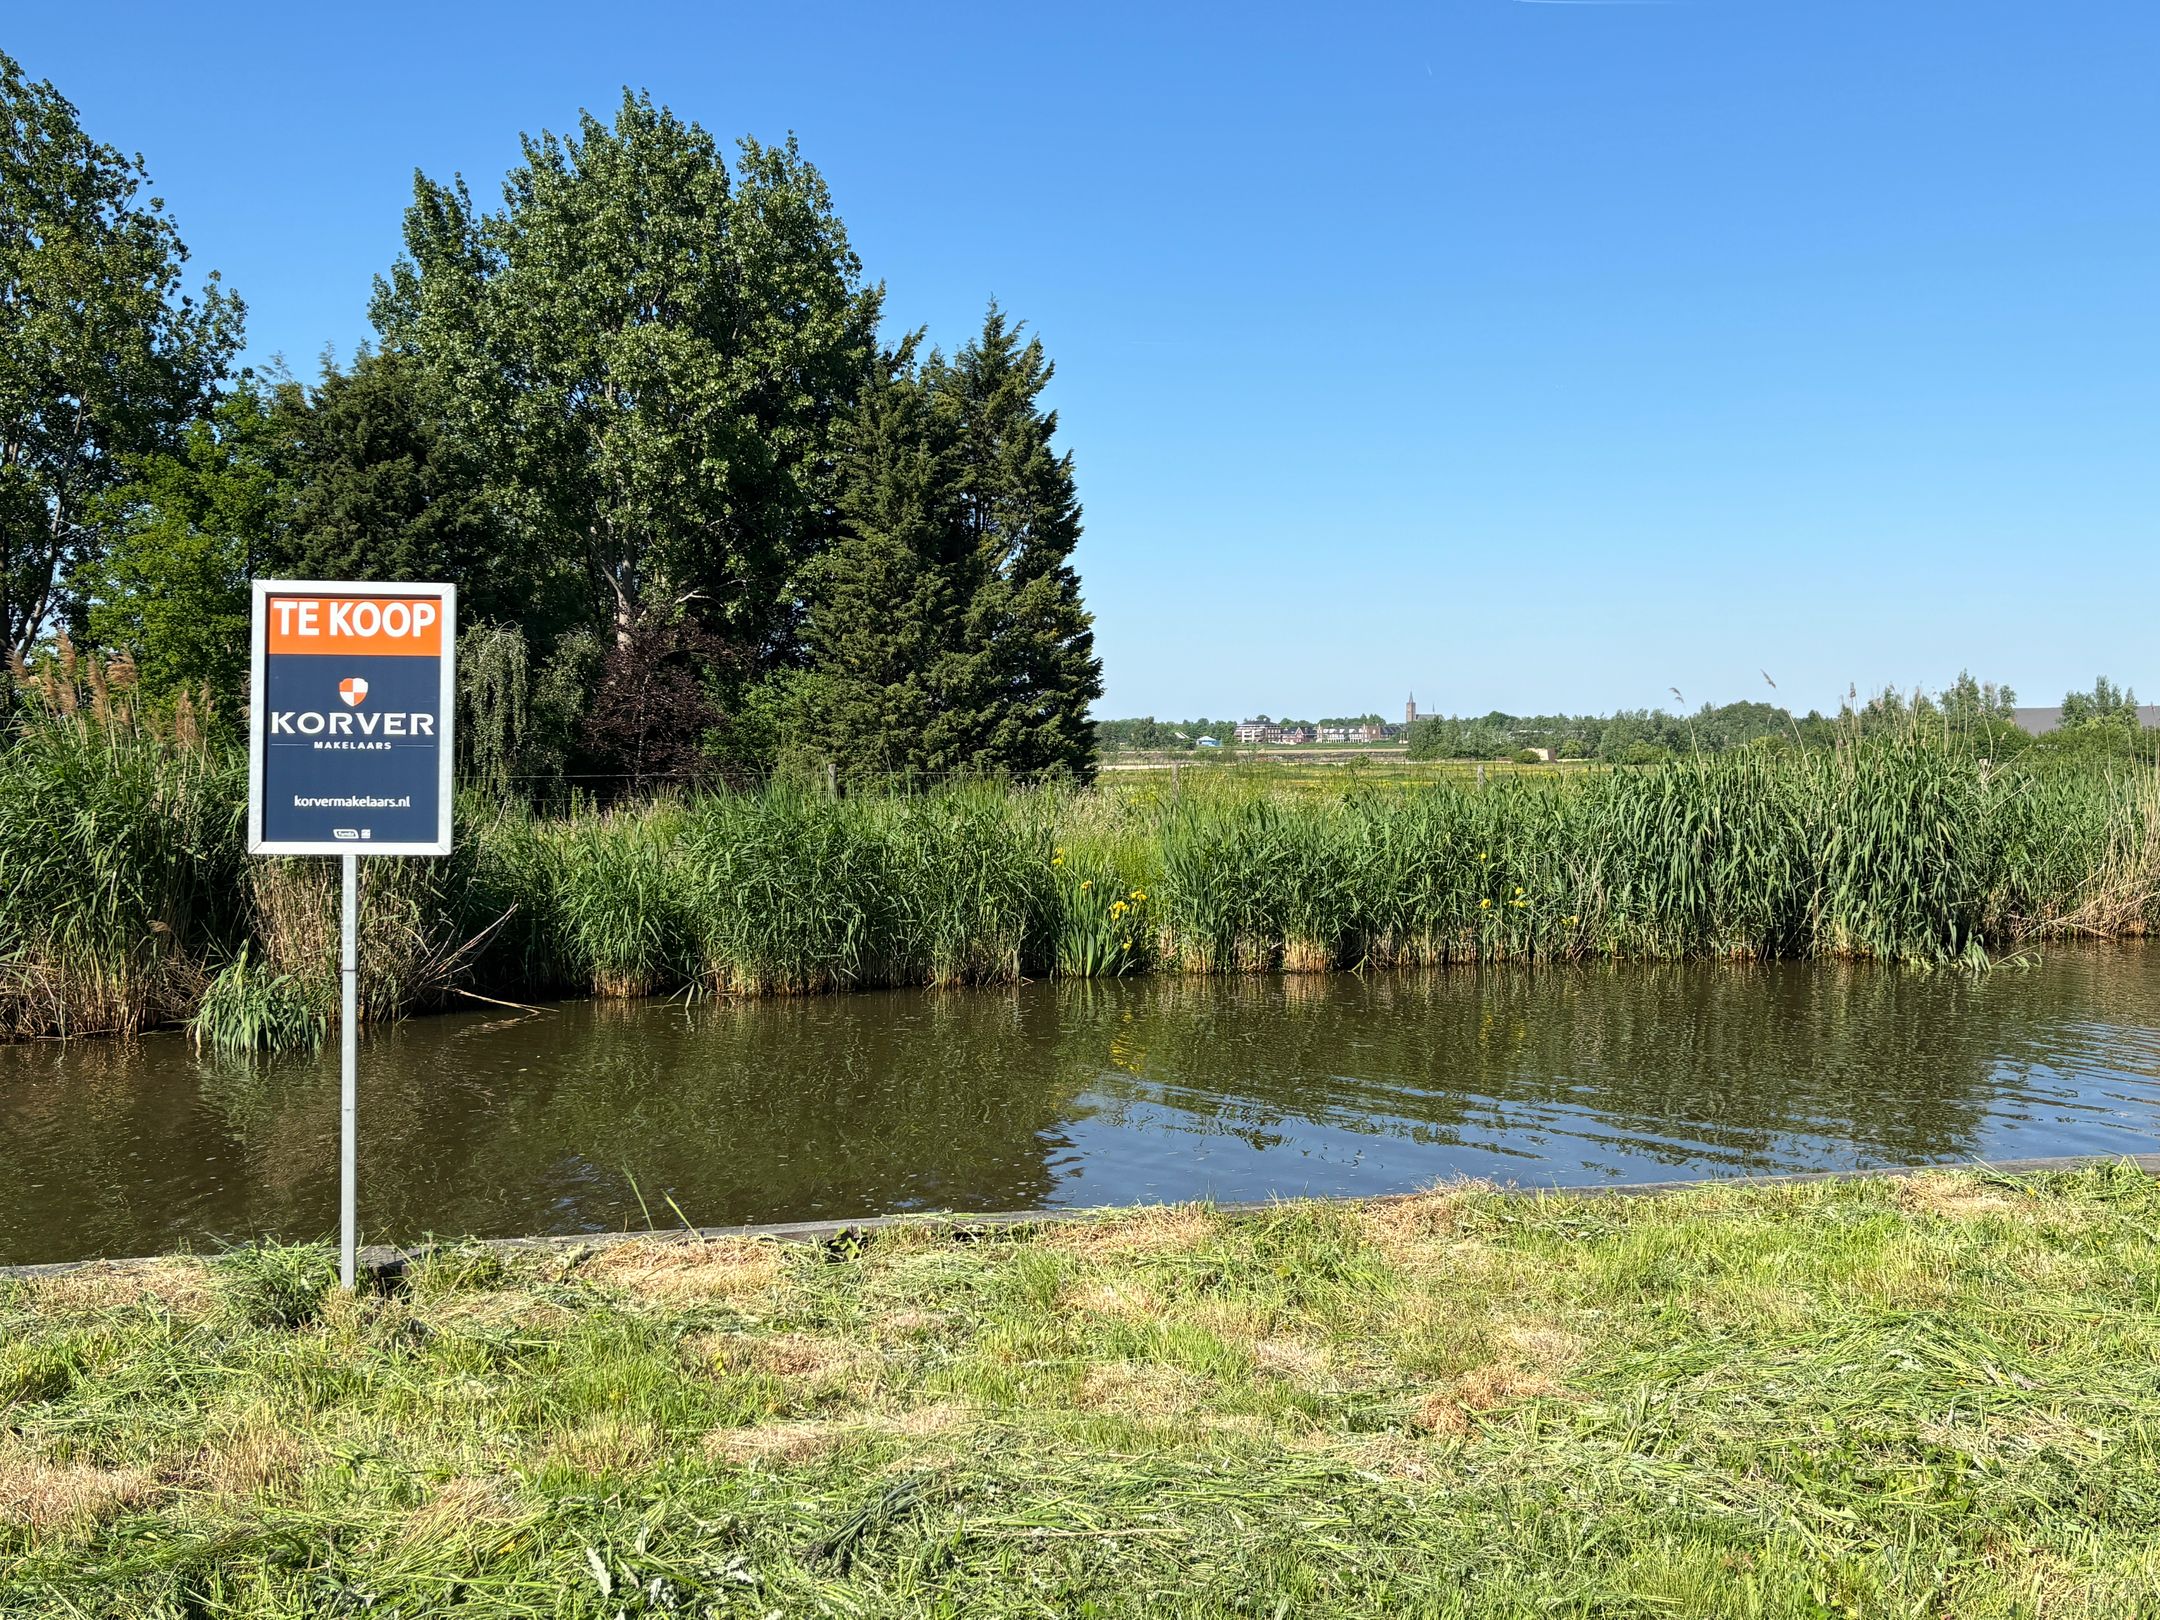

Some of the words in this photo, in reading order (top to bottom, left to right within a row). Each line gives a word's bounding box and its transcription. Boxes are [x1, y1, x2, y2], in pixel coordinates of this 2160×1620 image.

[273, 601, 320, 636] TE
[329, 602, 436, 638] KOOP
[271, 711, 435, 736] KORVER
[313, 741, 392, 750] MAKELAARS
[294, 795, 411, 808] korvermakelaars.nl
